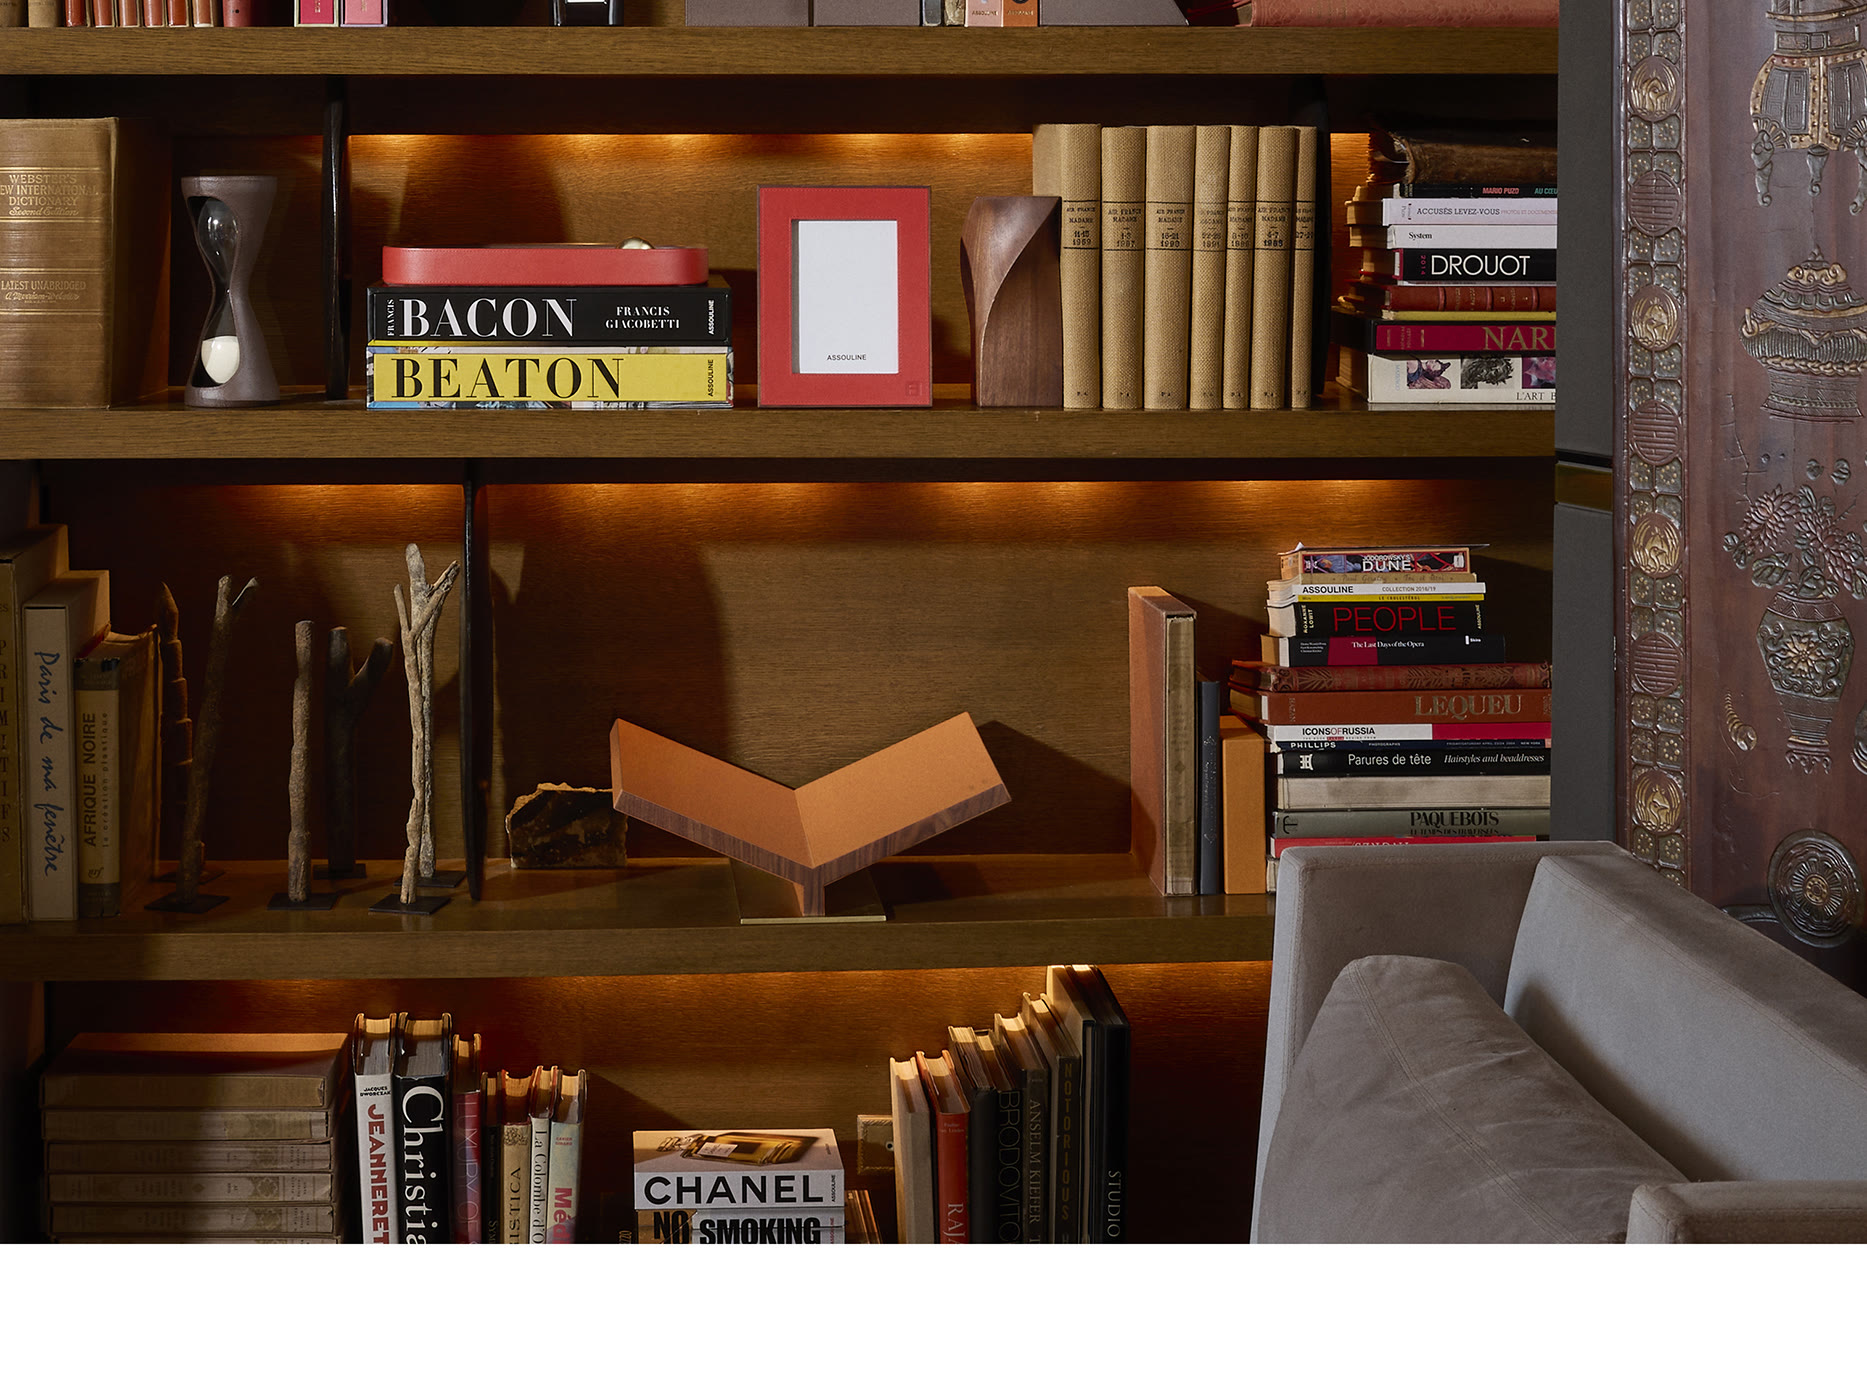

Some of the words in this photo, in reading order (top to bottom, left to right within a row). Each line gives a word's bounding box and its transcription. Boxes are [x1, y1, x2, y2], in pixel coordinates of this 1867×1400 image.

[0, 185, 14, 196] EW
[16, 184, 99, 196] INTERNATIONAL
[9, 174, 77, 184] WEBSTER'S
[9, 196, 79, 206] DICTIONARY
[9, 206, 44, 216] Second
[42, 206, 79, 216] Edition
[1416, 206, 1453, 215] ACCUSÉS
[1408, 231, 1433, 241] System
[1431, 254, 1531, 276] DROUOT
[1, 280, 29, 290] LATEST
[31, 280, 87, 290] UNABRIDGED
[386, 298, 396, 337] FRANCIS
[399, 297, 577, 338] BACON
[604, 319, 681, 330] GIACOBETTI
[615, 305, 671, 317] FRANCIS
[707, 299, 716, 336] ASSOULINE
[390, 357, 624, 400] BEATON
[1516, 391, 1545, 401] L'ART
[1362, 560, 1411, 572] DUNE
[1302, 585, 1354, 594] ASSOULINE
[1332, 605, 1457, 632] PEOPLE
[1377, 641, 1391, 649] Days
[1406, 641, 1425, 649] Opera
[34, 651, 60, 705] Paris
[1413, 694, 1523, 720] LEQUEU
[40, 715, 64, 745] de
[83, 712, 96, 763] NOIRE
[41, 757, 57, 792] ma
[1347, 753, 1391, 766] Parures
[1392, 753, 1406, 766] de
[1407, 753, 1432, 766] tête
[1443, 754, 1480, 765] Hairstyles
[1481, 754, 1499, 763] and
[83, 774, 97, 848] AFRIQUE
[1410, 811, 1500, 828] PAQUEBOTS
[34, 803, 65, 877] fenêtre
[534, 1130, 548, 1148] La
[1028, 1099, 1042, 1163] ANSELM
[1061, 1062, 1073, 1221] NOTORIOUS
[456, 1102, 479, 1192] LUXURY
[367, 1104, 390, 1243] JEANNERET
[534, 1153, 548, 1214] Colombe
[508, 1167, 521, 1243] ISTICA
[644, 1174, 824, 1206] CHANEL
[1028, 1170, 1041, 1225] KIEFER
[1106, 1169, 1121, 1238] STUDIO
[456, 1200, 479, 1233] OF
[653, 1210, 690, 1243] NO
[699, 1217, 821, 1243] SMOKING
[943, 1202, 965, 1243] RAJ
